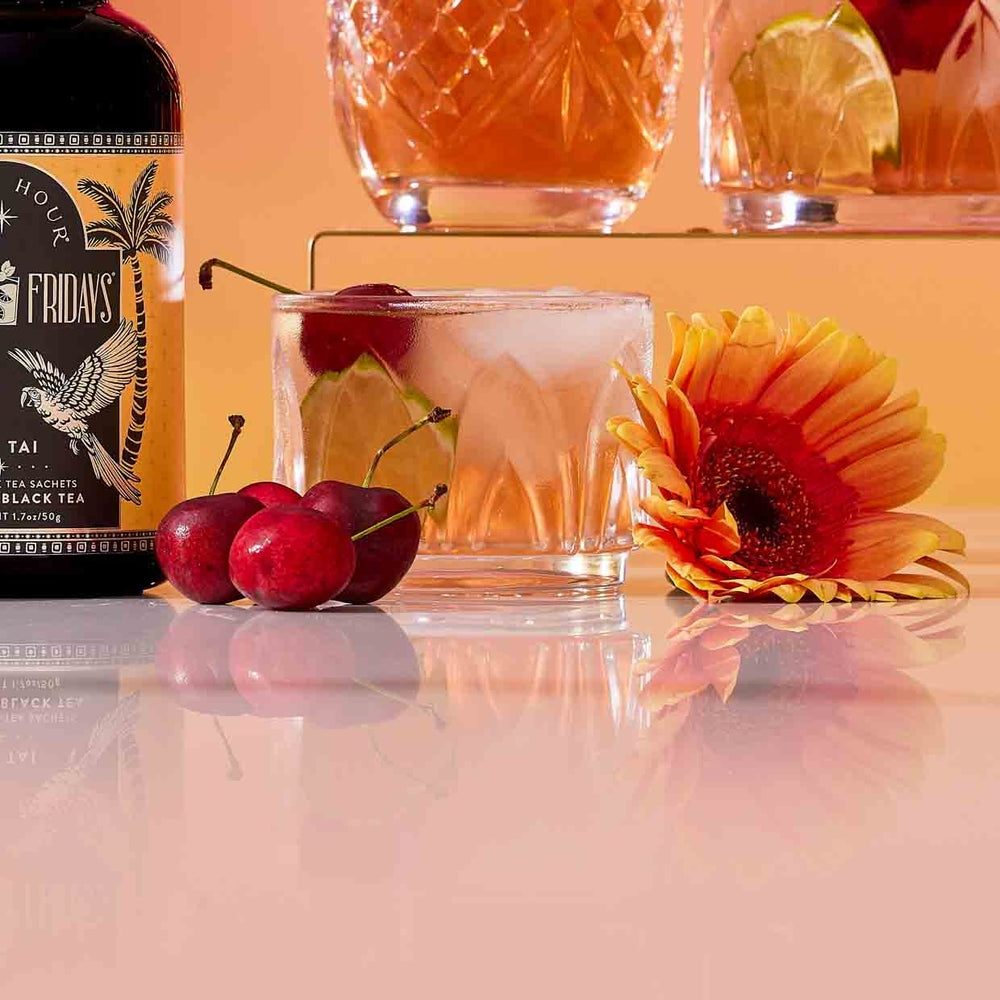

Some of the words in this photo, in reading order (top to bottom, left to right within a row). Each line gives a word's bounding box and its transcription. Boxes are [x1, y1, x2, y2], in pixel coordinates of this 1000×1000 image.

[15, 178, 68, 247] HOUR
[27, 272, 113, 323] FRIDAYS
[8, 440, 38, 453] TAI
[6, 479, 26, 488] TEA
[29, 479, 77, 488] SACHETS
[2, 493, 52, 504] BLACK
[58, 493, 85, 503] TEA
[12, 512, 61, 523] 1.7oz/50g
